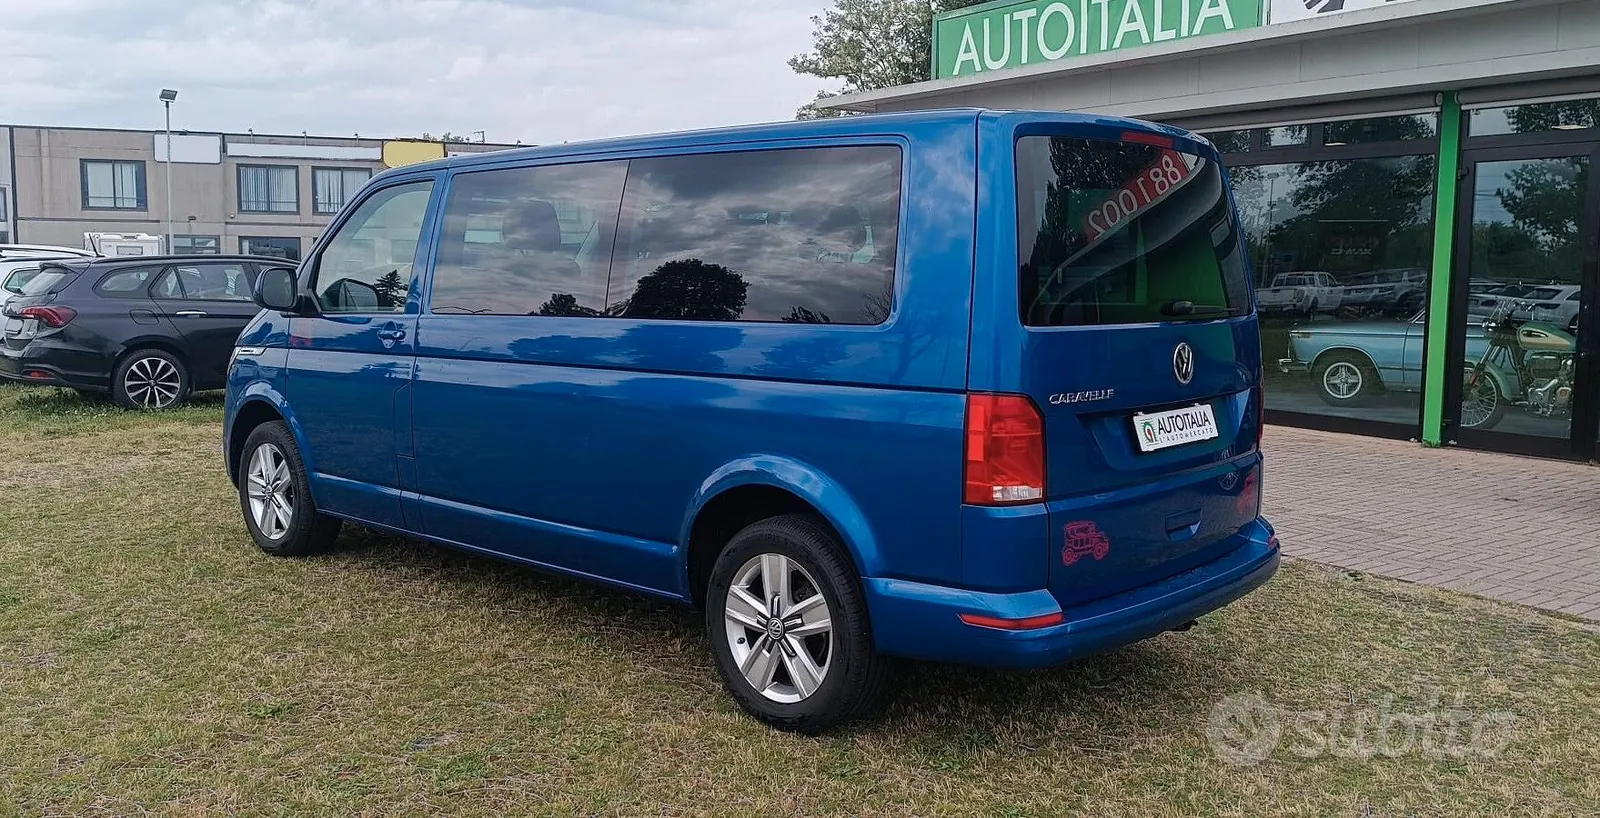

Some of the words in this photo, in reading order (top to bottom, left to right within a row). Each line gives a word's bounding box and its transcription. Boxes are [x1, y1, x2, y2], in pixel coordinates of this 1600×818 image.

[952, 0, 1235, 76] AUTOITALIA
[1048, 388, 1114, 405] CARAVELLE
[1157, 412, 1211, 435] AUTOITALIA
[1159, 428, 1213, 444] L'AUTOMERCATO
